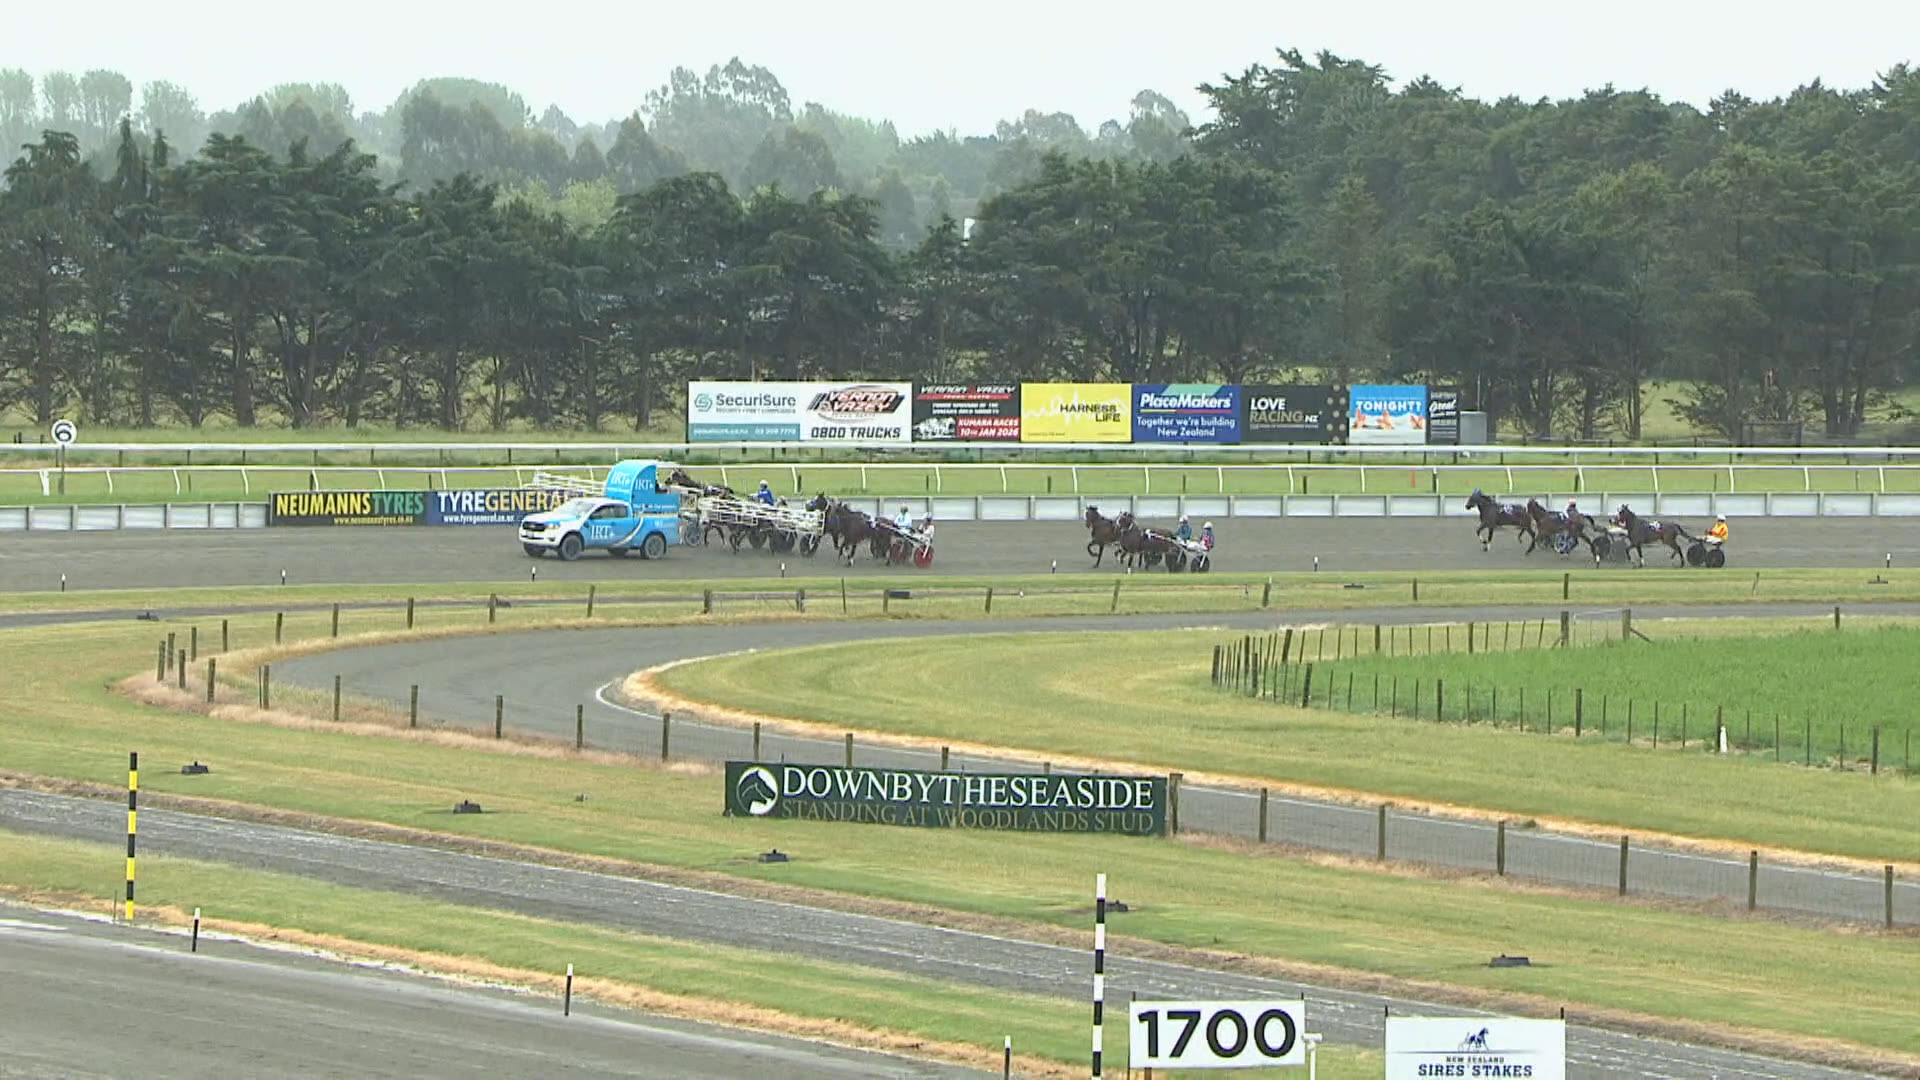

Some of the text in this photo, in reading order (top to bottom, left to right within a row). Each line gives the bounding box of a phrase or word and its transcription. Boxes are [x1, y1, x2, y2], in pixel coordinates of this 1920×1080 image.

[715, 393, 797, 407] SecuriSure
[827, 391, 896, 402] VERNON
[1140, 392, 1232, 409] PlaceMakers
[833, 402, 892, 412] VAZEY
[1060, 404, 1117, 413] HARNESS
[1250, 397, 1287, 411] LOVE
[958, 418, 1019, 427] KUMARA RACES
[1095, 413, 1121, 423] LIFE
[1137, 416, 1175, 428] Together
[1175, 417, 1199, 426] we're
[1201, 416, 1236, 429] building
[1250, 411, 1319, 424] RACING NZ
[55, 422, 73, 442] 6
[811, 427, 901, 439] 0800 TRUCKS
[979, 428, 997, 437] JAN
[997, 428, 1019, 437] 2026
[1157, 427, 1216, 437] New Zealand
[591, 525, 612, 540] IRT
[783, 767, 1154, 809] DOWNBYTHESEASIDE
[782, 800, 1154, 832] STANDING AT WOODLANDS STUD
[1137, 1009, 1296, 1059] 1700
[1471, 1064, 1533, 1077] STAKES
